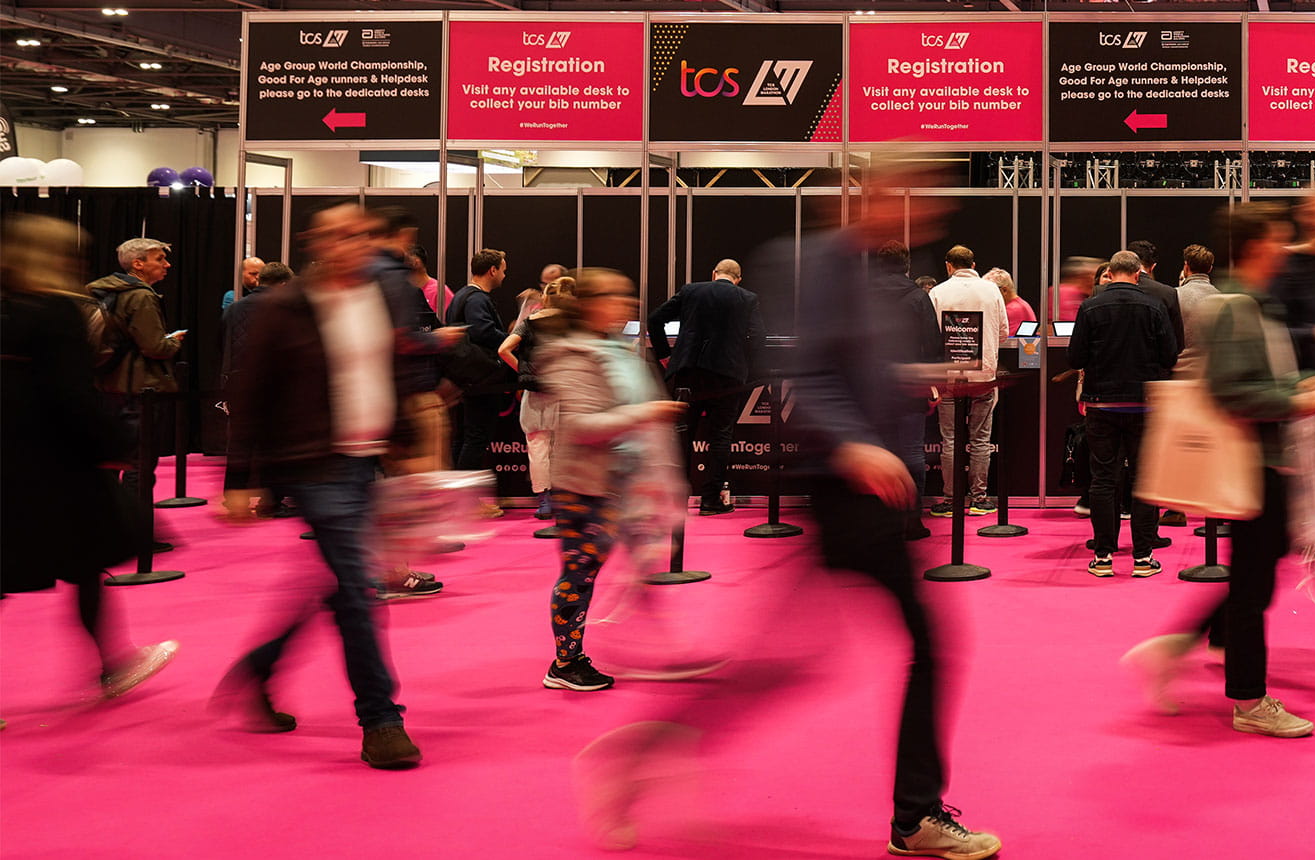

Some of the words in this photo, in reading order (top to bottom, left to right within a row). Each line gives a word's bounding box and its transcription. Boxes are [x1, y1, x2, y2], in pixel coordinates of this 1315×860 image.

[299, 30, 323, 45] tcs
[522, 31, 545, 46] tcs
[921, 32, 944, 47] tcs
[1099, 31, 1122, 46] tcs
[259, 61, 282, 73] Age
[283, 61, 316, 72] Group
[317, 60, 348, 70] World
[350, 60, 428, 72] Championship,
[488, 56, 605, 77] Registration
[887, 58, 1005, 78] Registration
[1060, 62, 1082, 74] Age
[1083, 62, 1116, 73] Group
[1118, 62, 1148, 72] World
[1150, 61, 1227, 73] Championship,
[257, 75, 287, 85] Good
[289, 74, 306, 84] For
[307, 74, 329, 86] Age
[330, 76, 368, 84] runners
[370, 74, 378, 84] &
[380, 74, 429, 85] Helpdesk
[681, 59, 740, 98] tcs
[1058, 76, 1088, 86] Good
[1090, 76, 1106, 85] For
[1107, 76, 1129, 87] Age
[1131, 77, 1169, 85] runners
[1170, 75, 1179, 85] &
[1180, 75, 1228, 86] Helpdesk
[259, 88, 295, 100] please
[296, 90, 311, 100] go
[313, 88, 324, 98] to
[325, 88, 343, 98] the
[344, 87, 398, 98] dedicated
[399, 87, 430, 97] desks
[461, 84, 490, 95] Visit
[492, 86, 517, 97] any
[519, 84, 580, 96] available
[583, 85, 614, 96] desk
[616, 85, 630, 96] to
[862, 86, 890, 97] Visit
[892, 88, 917, 99] any
[919, 85, 980, 97] available
[983, 85, 1014, 97] desk
[1016, 85, 1030, 96] to
[1060, 90, 1096, 101] please
[1097, 91, 1112, 101] go
[1113, 89, 1125, 99] to
[1126, 89, 1144, 99] the
[1145, 89, 1198, 99] dedicated
[1200, 89, 1230, 98] desks
[1261, 85, 1289, 97] Visit
[1291, 87, 1315, 99] any
[469, 98, 515, 109] collect
[517, 100, 546, 111] your
[548, 98, 570, 110] bib
[572, 98, 622, 110] number
[870, 99, 915, 111] collect
[917, 101, 946, 113] your
[949, 99, 970, 110] bib
[973, 99, 1022, 110] number
[1269, 99, 1314, 110] collect
